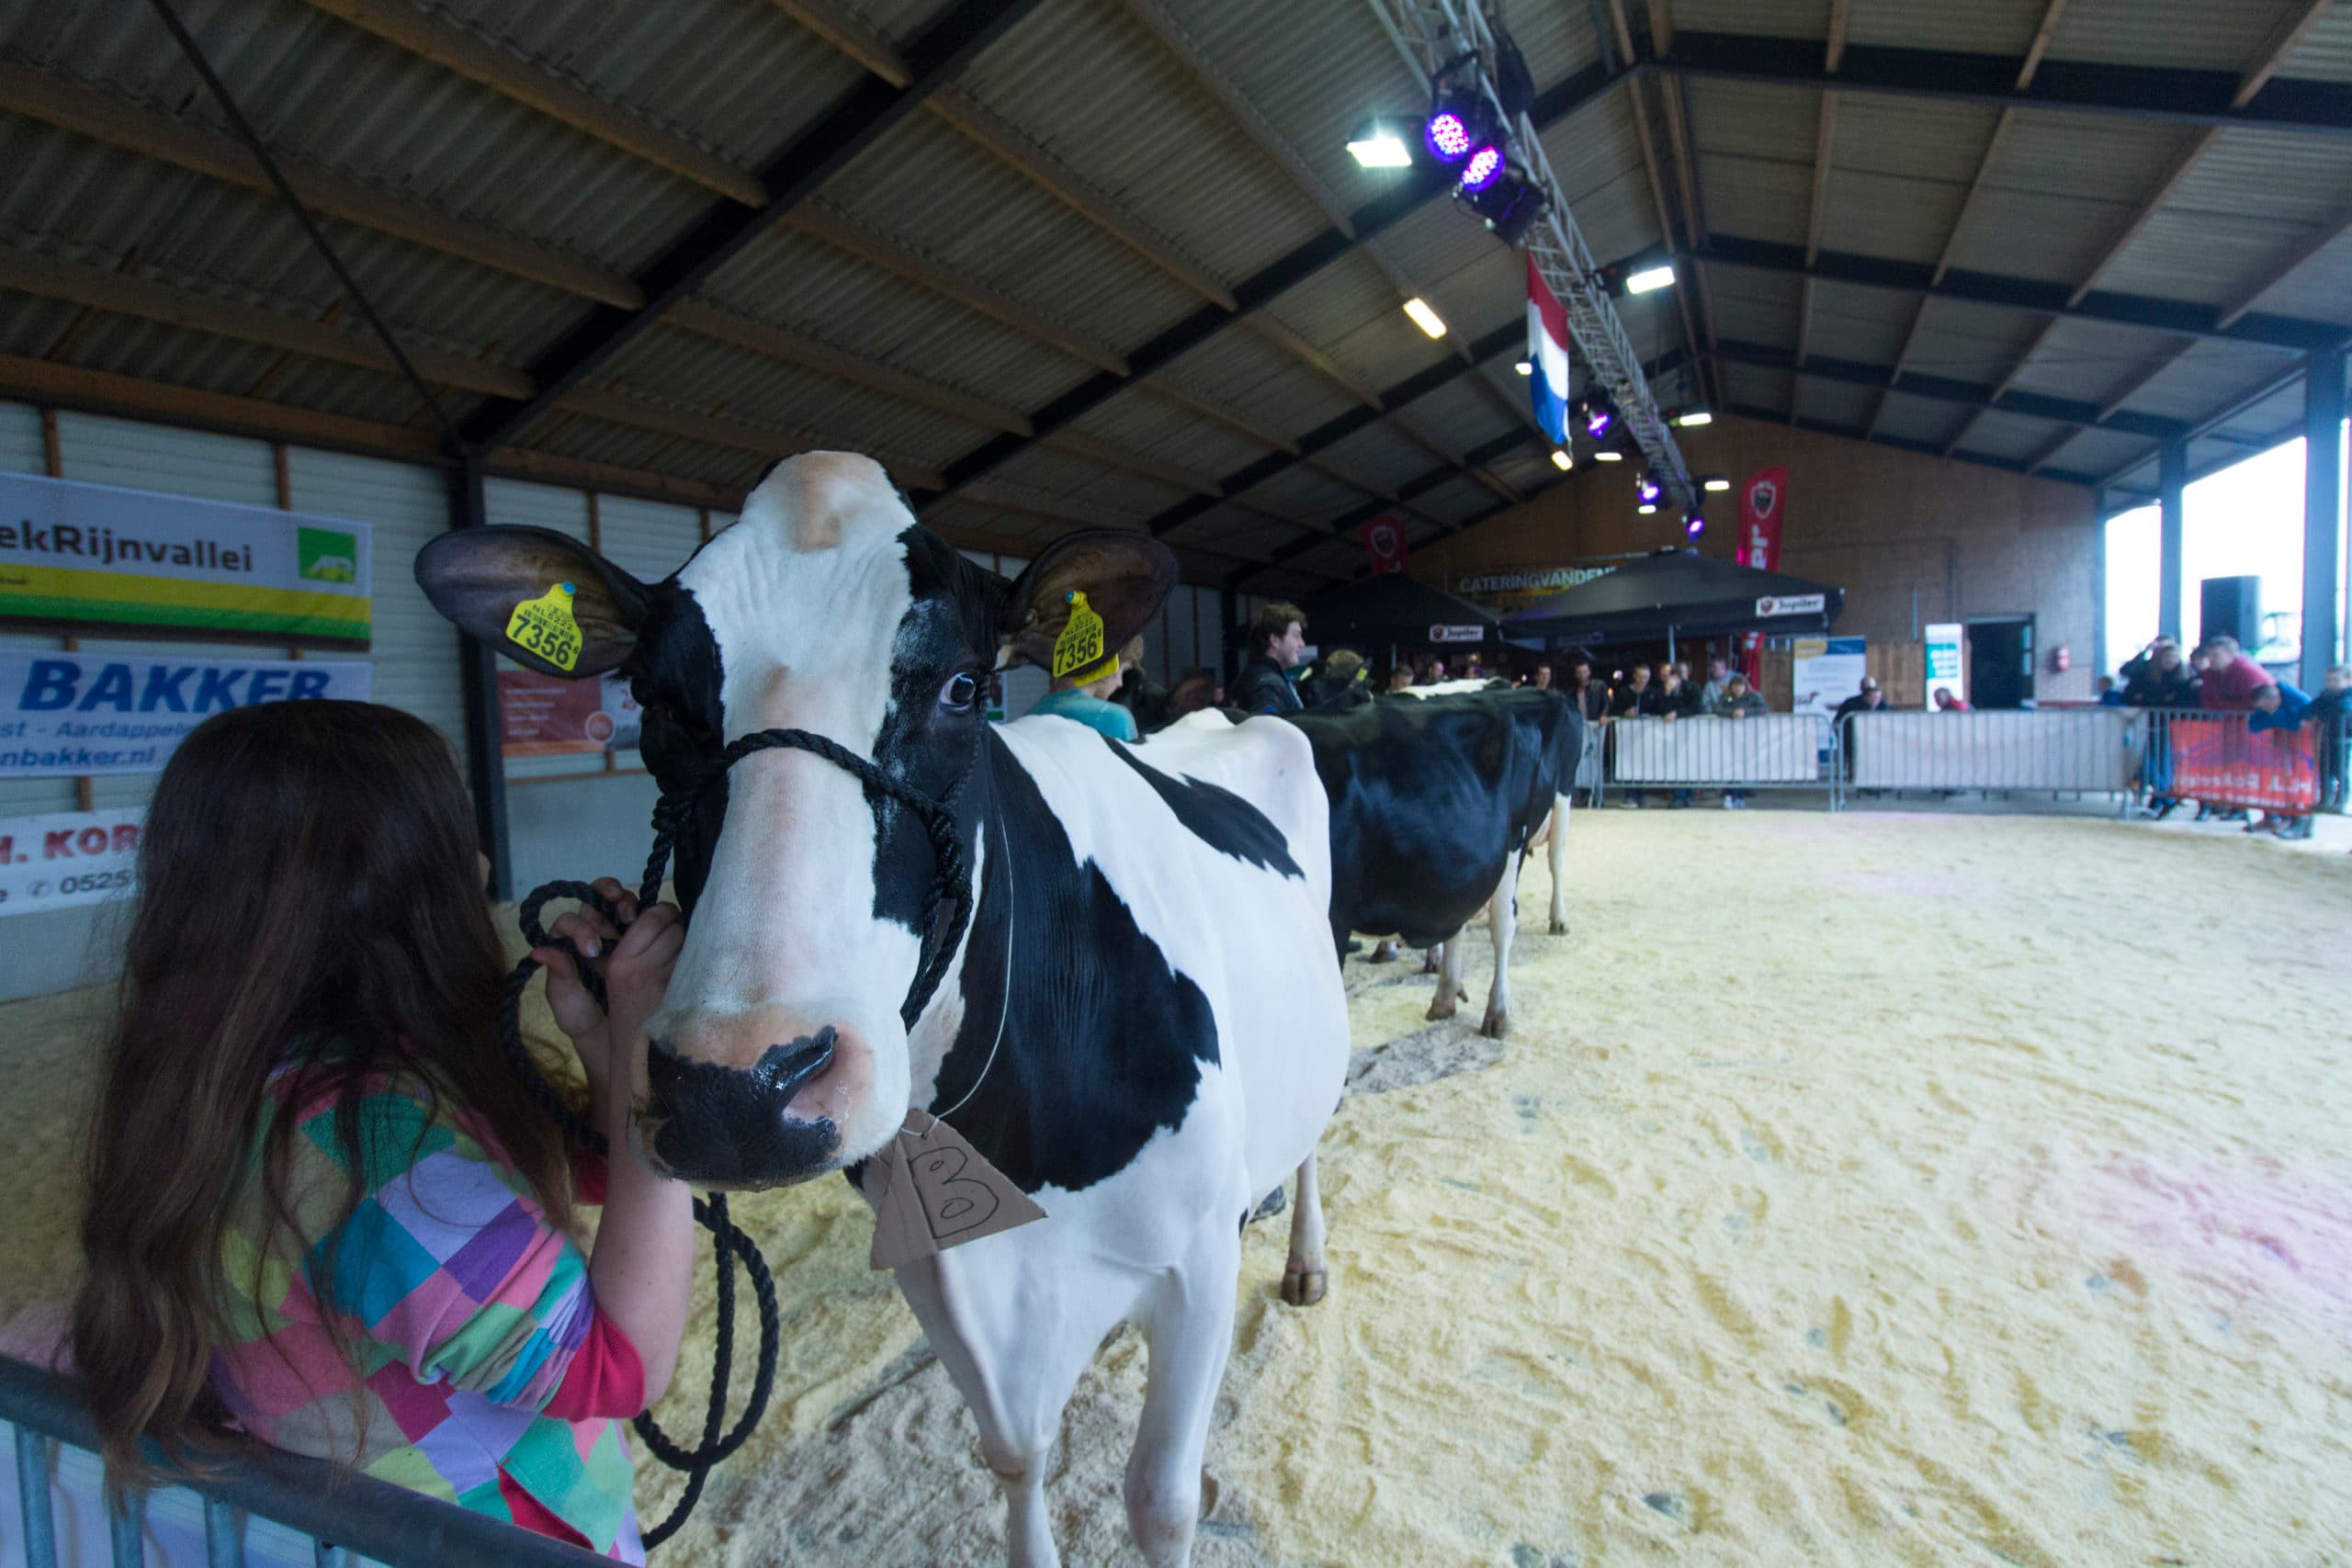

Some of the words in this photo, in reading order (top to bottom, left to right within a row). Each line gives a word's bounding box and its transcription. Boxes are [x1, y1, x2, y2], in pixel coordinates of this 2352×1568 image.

[512, 614, 571, 665] 7356
[1056, 632, 1098, 673] 7356
[18, 660, 332, 713] BAKKER
[907, 1145, 1000, 1240] B
